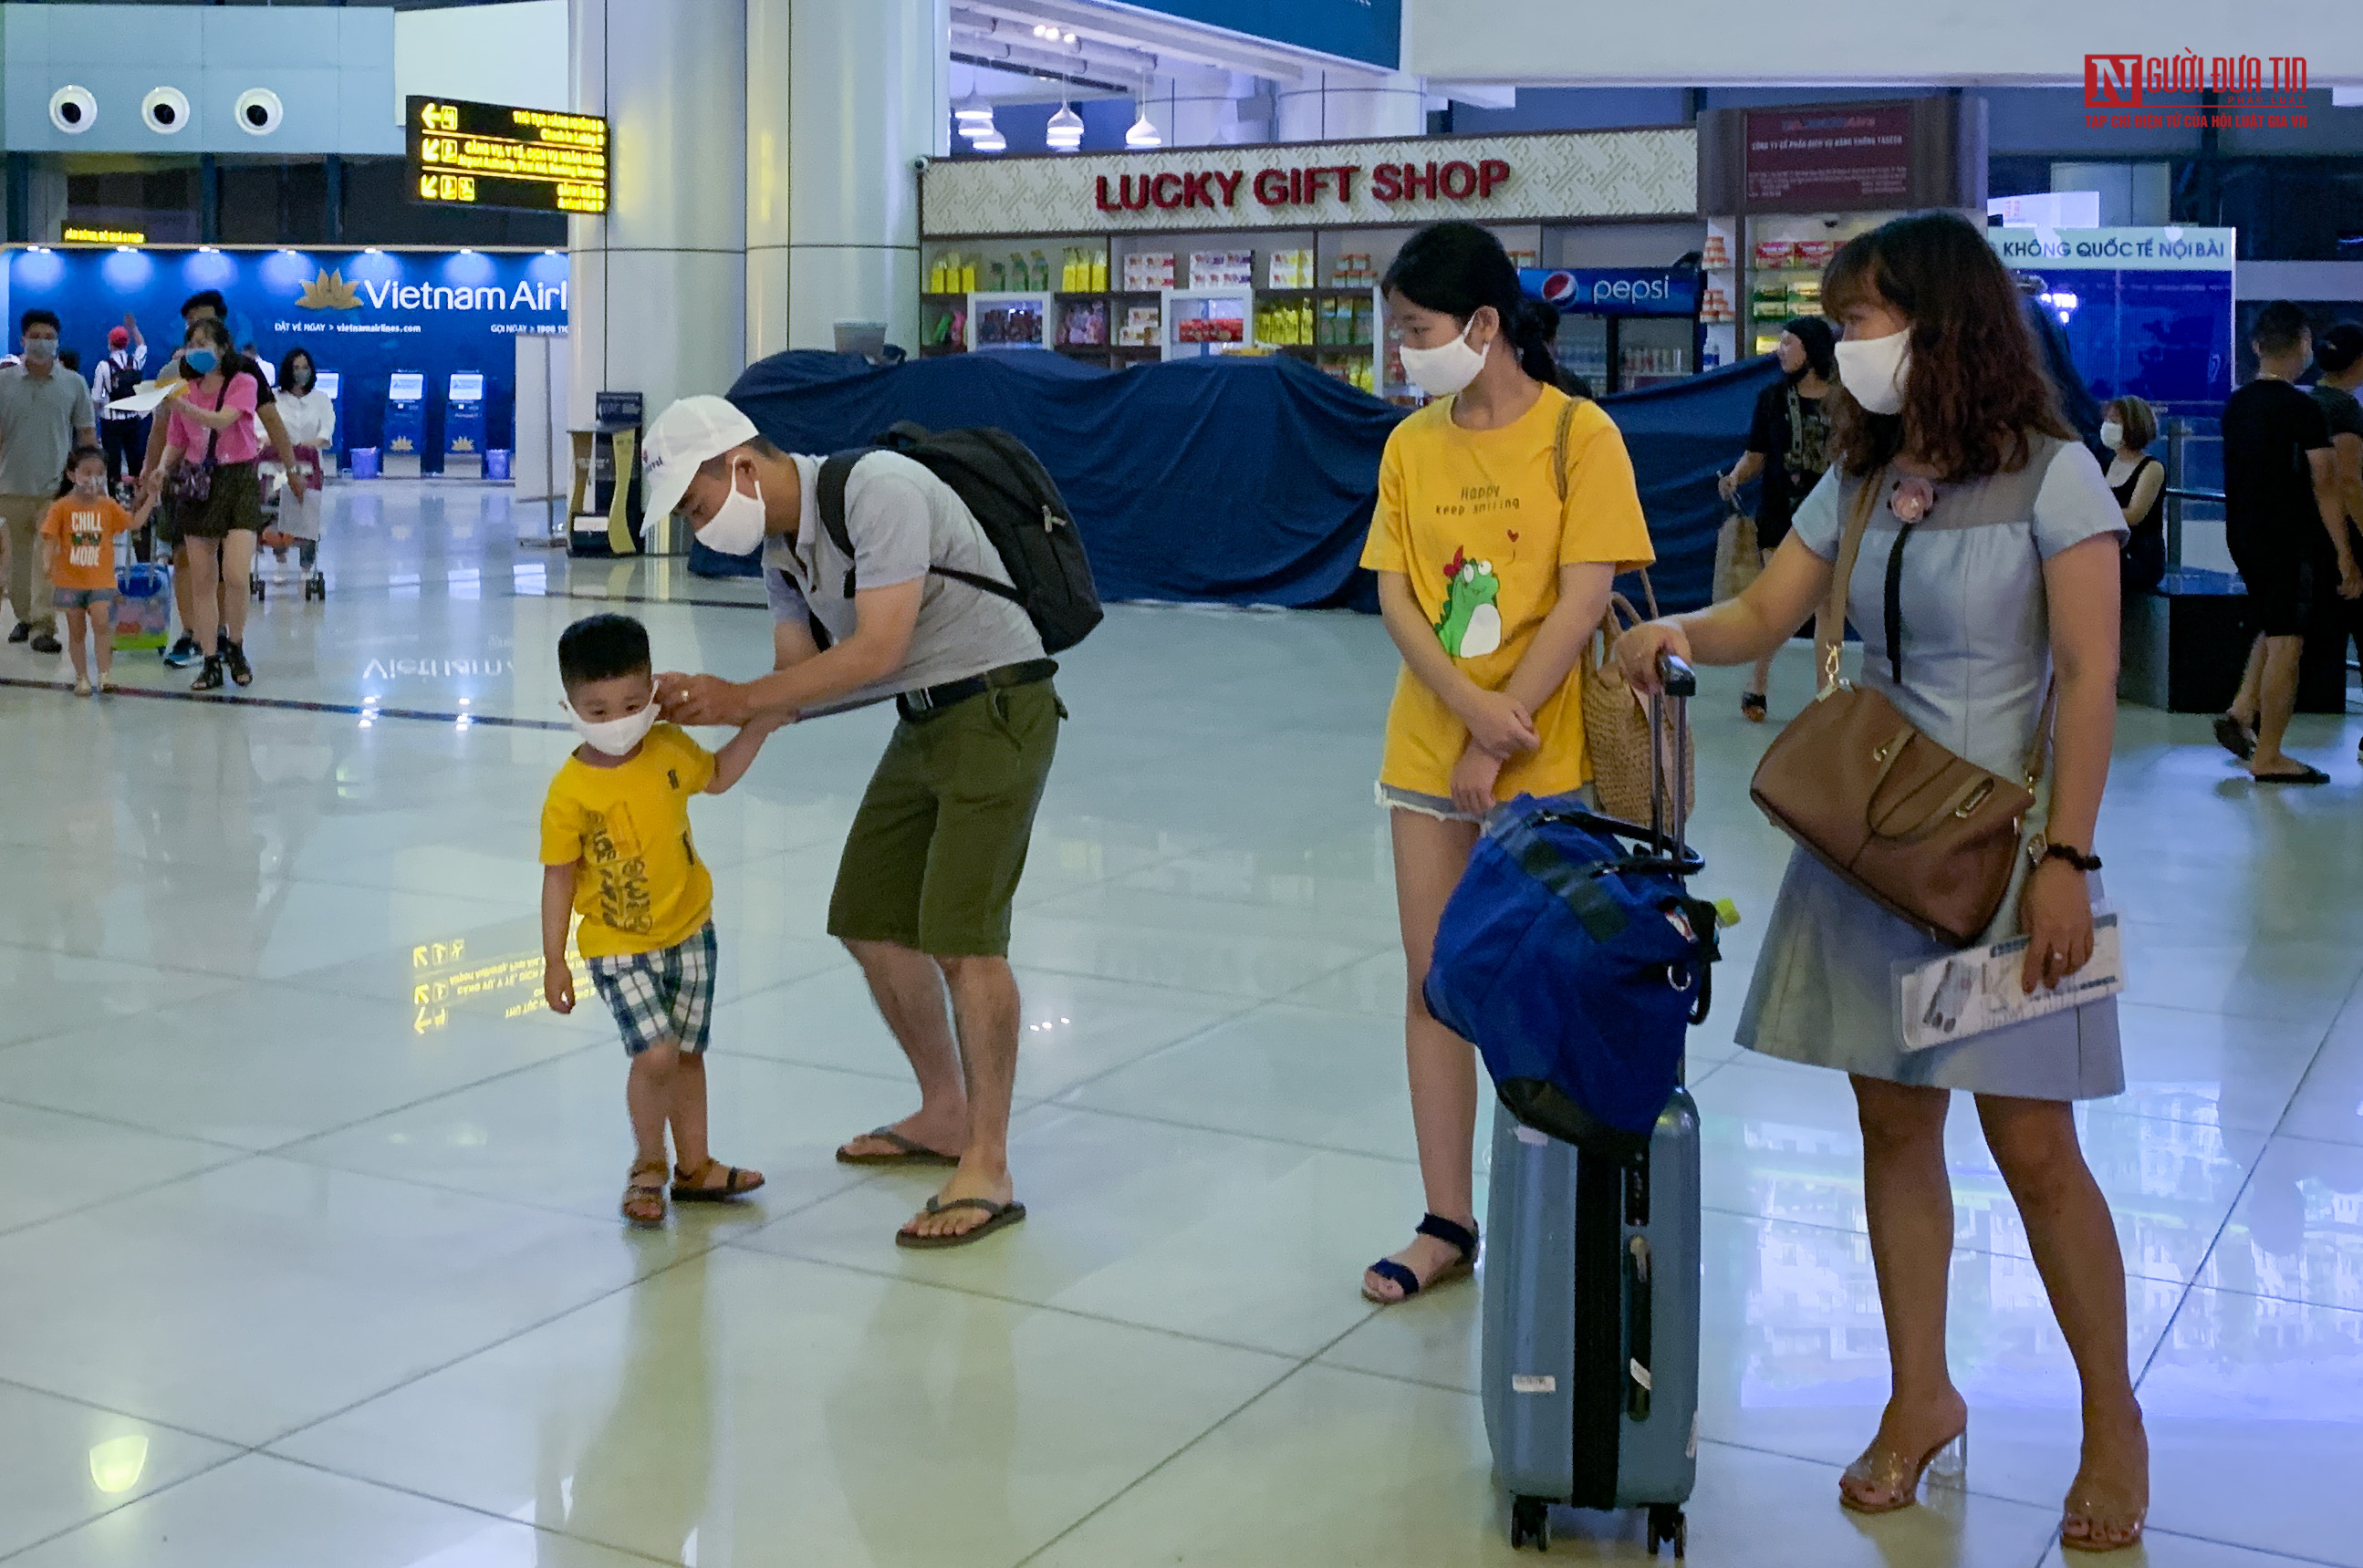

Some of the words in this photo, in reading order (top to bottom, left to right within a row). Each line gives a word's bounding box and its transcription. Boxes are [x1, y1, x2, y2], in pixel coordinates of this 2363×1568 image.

[1096, 170, 1243, 212] LUCKY
[1253, 165, 1359, 206] GIFT
[1370, 160, 1511, 202] SHOP
[2003, 239, 2071, 257] KHÔNG
[2076, 237, 2133, 257] QUỐC
[2136, 237, 2154, 257] TẾ
[2159, 238, 2192, 260] NỘI
[2195, 238, 2224, 257] BÀI
[364, 279, 505, 310] Vietnam
[1594, 275, 1669, 304] pepsi
[304, 323, 326, 332] NGAY
[1436, 504, 1465, 516] keep
[72, 512, 102, 532] CHILL
[70, 545, 99, 566] MODE
